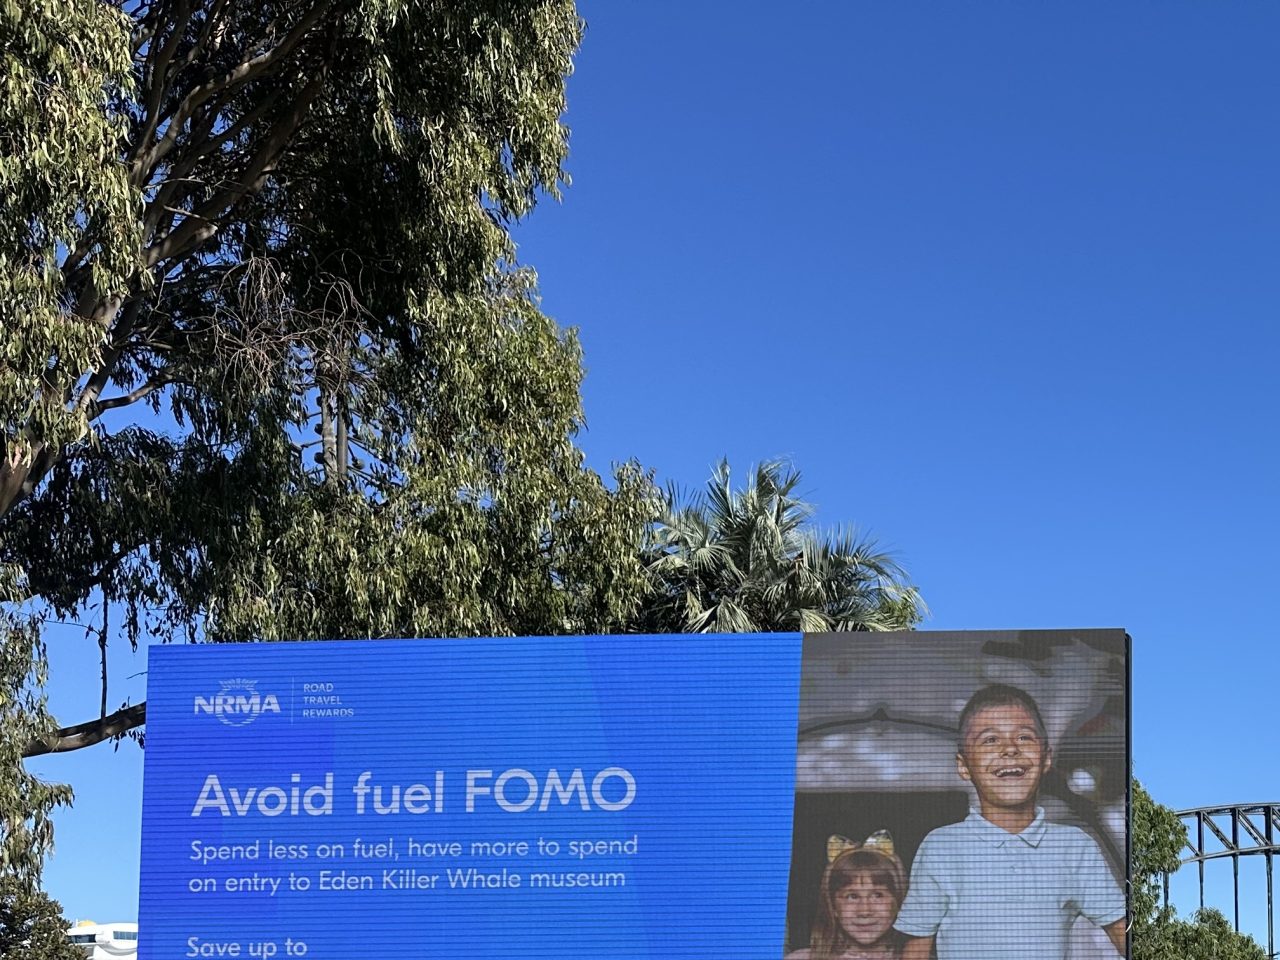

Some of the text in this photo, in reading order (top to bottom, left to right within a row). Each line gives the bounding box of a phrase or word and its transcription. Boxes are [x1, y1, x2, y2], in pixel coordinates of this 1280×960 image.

[303, 683, 334, 693] ROAD
[194, 694, 281, 714] NRMA
[303, 696, 343, 705] TRAVEL
[302, 708, 354, 718] REWARDS
[191, 767, 637, 817] Avoid fuel FOMO
[189, 834, 638, 865] Spend less on fuel, have more to spend
[188, 868, 626, 896] on entry to Eden Killer Whale museum
[186, 937, 308, 960] Save up to
